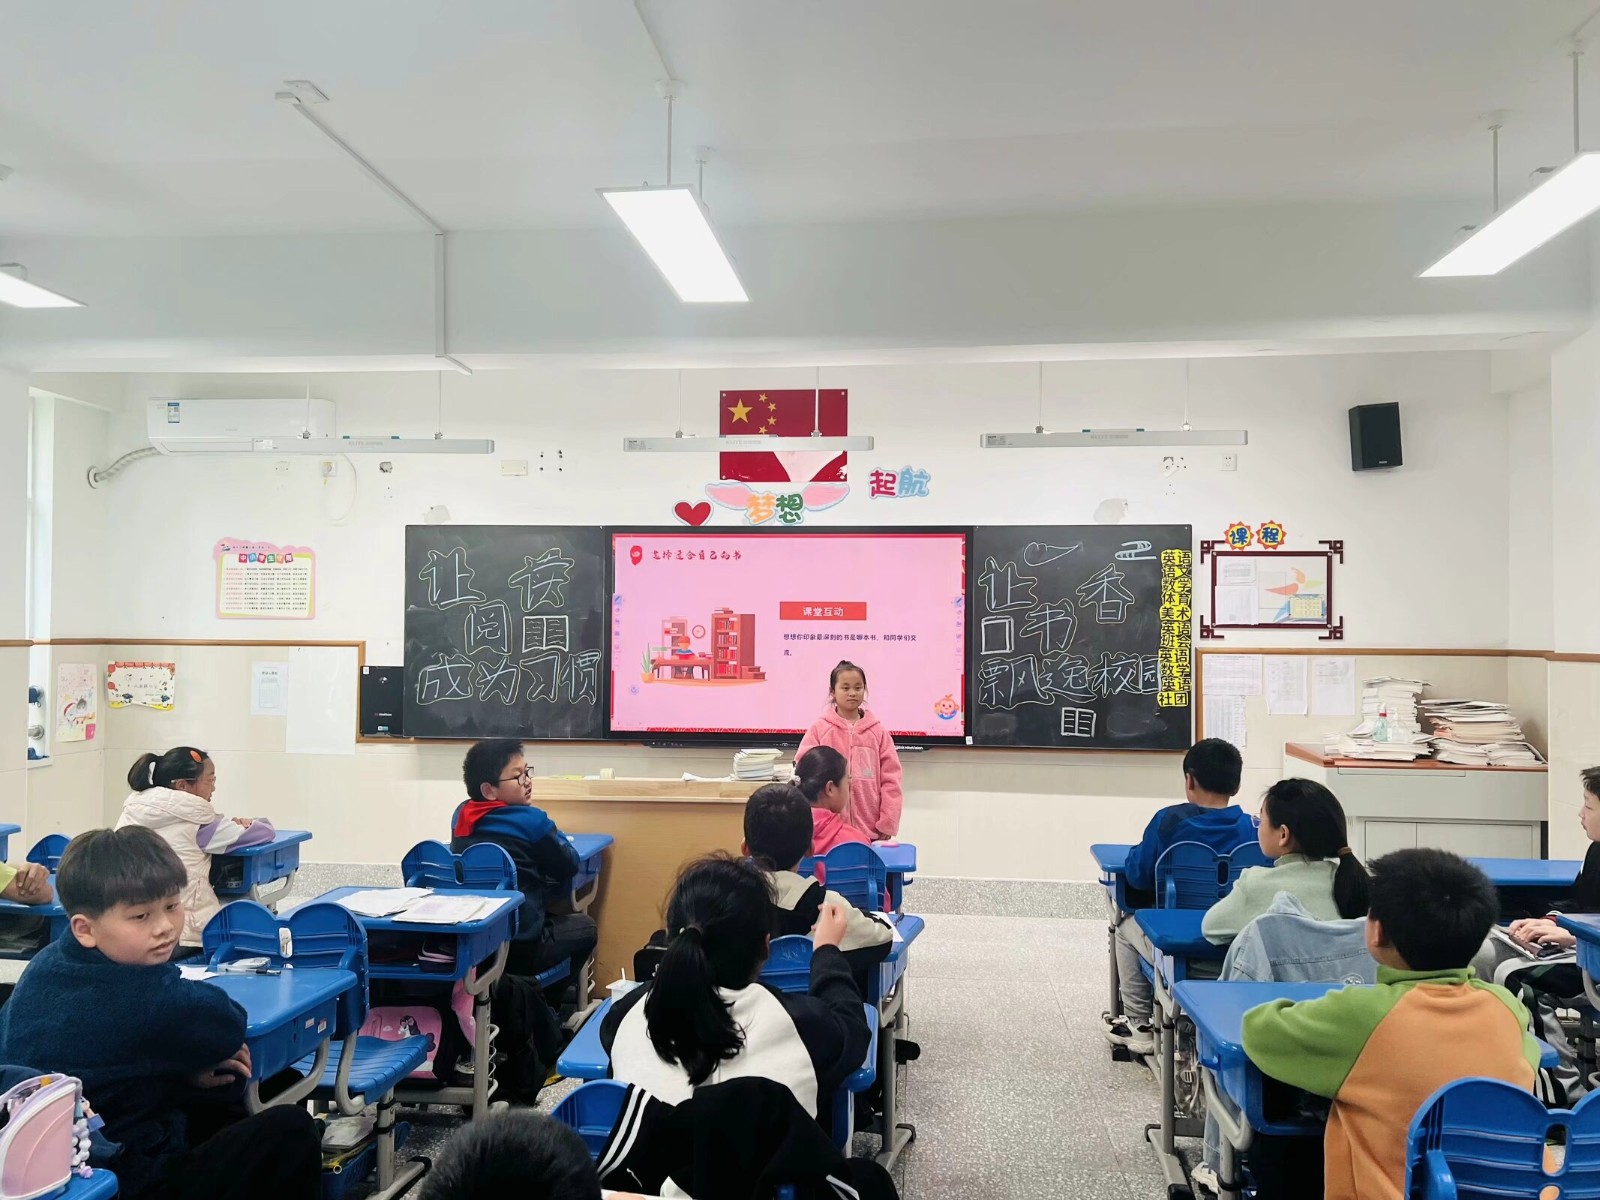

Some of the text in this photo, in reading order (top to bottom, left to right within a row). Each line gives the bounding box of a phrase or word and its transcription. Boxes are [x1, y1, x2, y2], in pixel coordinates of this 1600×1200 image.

[869, 468, 930, 497] 起航
[746, 493, 804, 524] 梦想
[1229, 527, 1279, 544] 课程
[1162, 551, 1192, 565] 英语
[1162, 565, 1191, 578] 语文
[1162, 578, 1191, 592] 数学
[1162, 592, 1191, 605] 体育
[803, 607, 844, 617] 课堂互动
[1161, 606, 1190, 620] 美术
[1161, 622, 1191, 635] 英语
[1160, 635, 1190, 648] 班会
[1160, 649, 1188, 663] 英语
[1160, 663, 1189, 676] 数学
[1162, 677, 1191, 691] 英语
[1159, 692, 1188, 706] 社团
